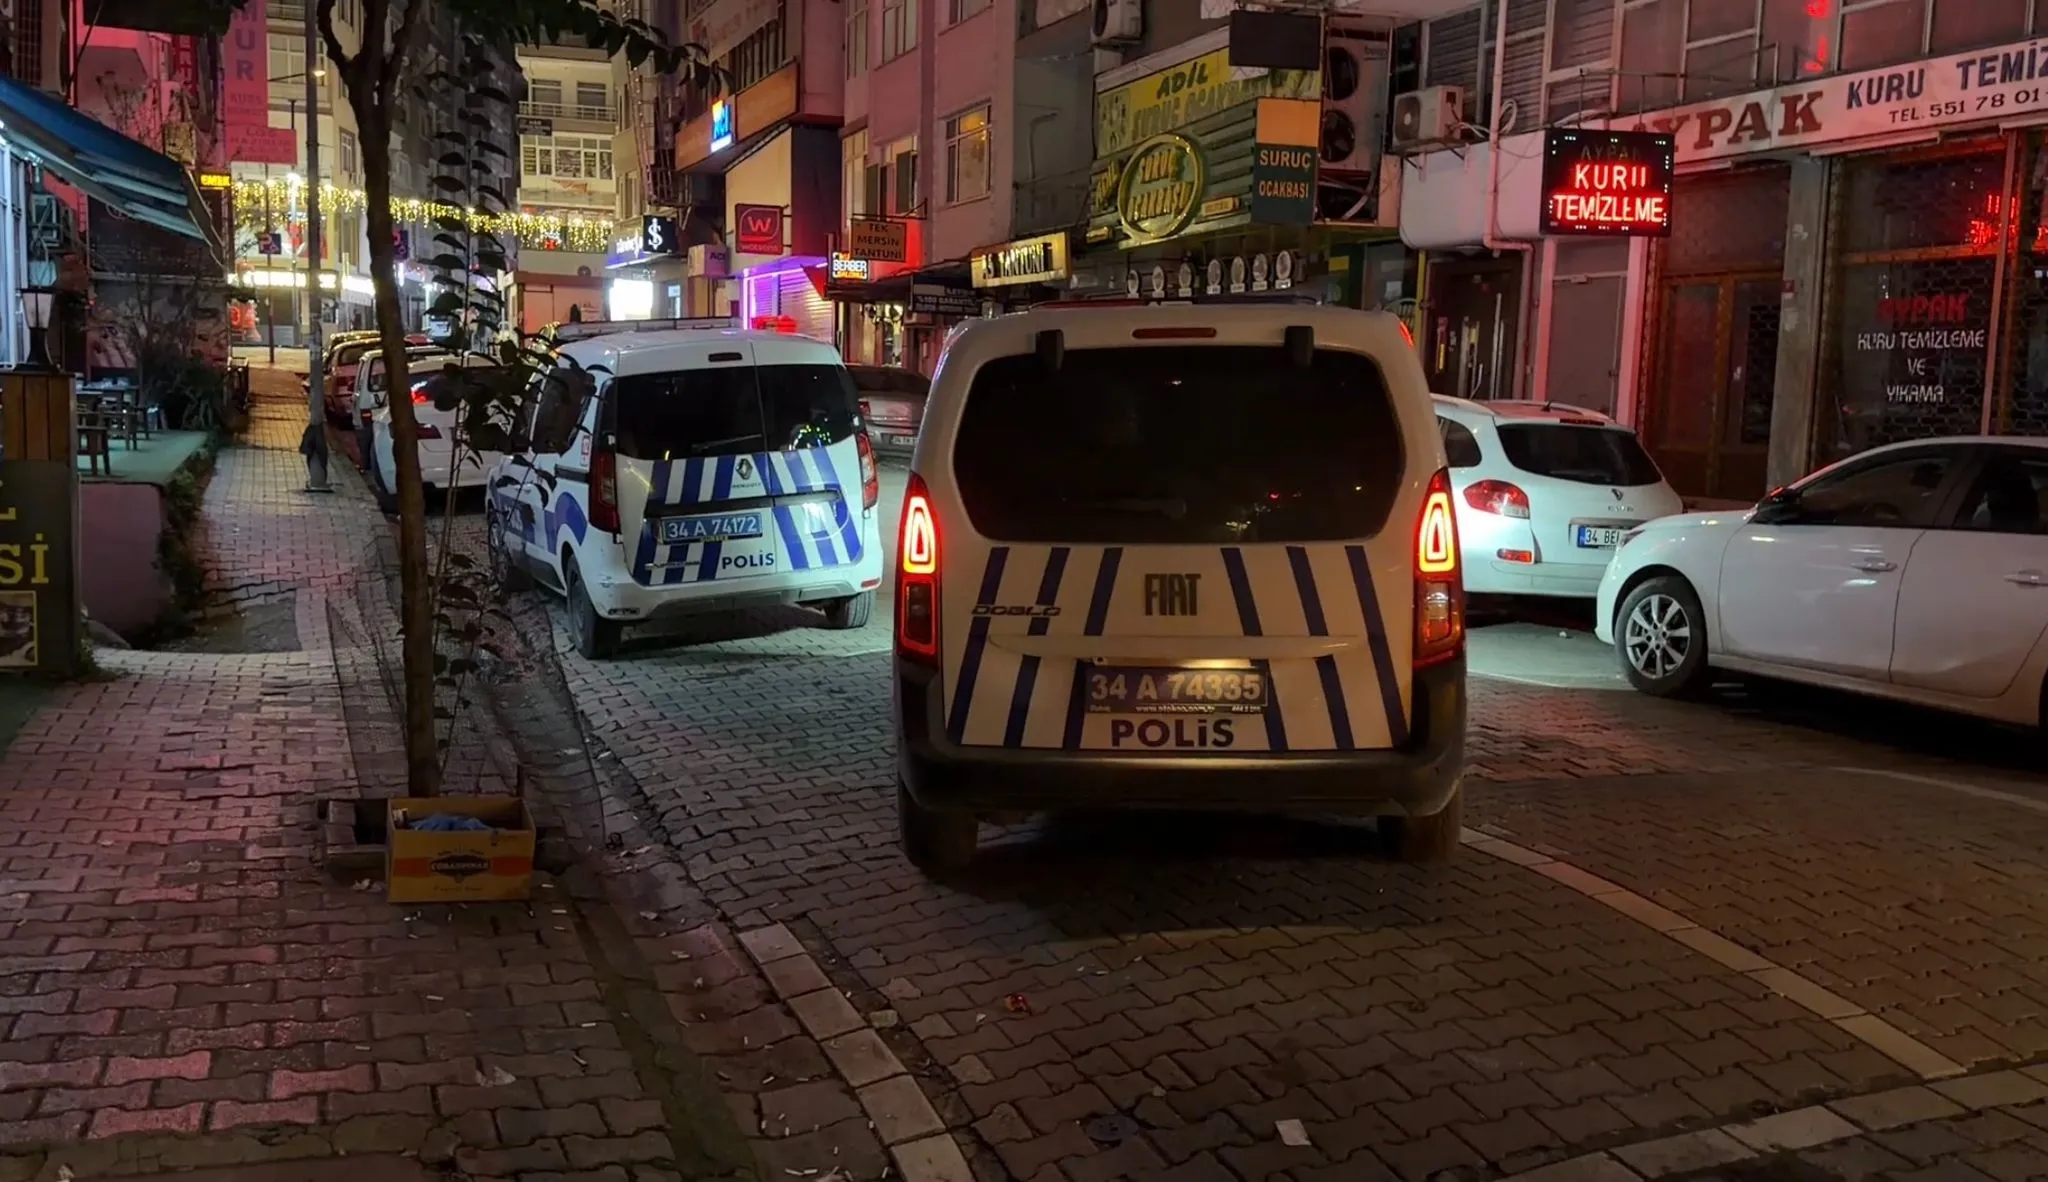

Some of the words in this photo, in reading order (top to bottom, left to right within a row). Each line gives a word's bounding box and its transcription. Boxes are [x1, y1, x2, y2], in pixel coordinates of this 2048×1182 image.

[1847, 69, 1924, 109] KURU
[1889, 108, 1925, 123] TEL.
[1930, 101, 1966, 117] 551
[1976, 94, 2005, 111] 78
[1632, 91, 1823, 152] YPAK
[1260, 149, 1311, 172] SURUÇ
[1553, 191, 1664, 222] TEMİZLEME
[869, 223, 889, 233] TEK
[833, 259, 867, 272] BERBER
[1900, 327, 1985, 349] TEMİZLEME
[1907, 358, 1926, 376] VE
[1887, 384, 1944, 404] YIKAMA
[668, 522, 688, 538] 34
[694, 521, 706, 536] A
[711, 516, 758, 535] 74172
[1586, 529, 1598, 543] 34
[722, 550, 774, 569] POLİS
[1144, 573, 1202, 616] FIAT
[971, 605, 1061, 617] DOBLO
[1091, 674, 1127, 700] 34
[1136, 675, 1158, 700] A
[1167, 673, 1262, 701] 74335
